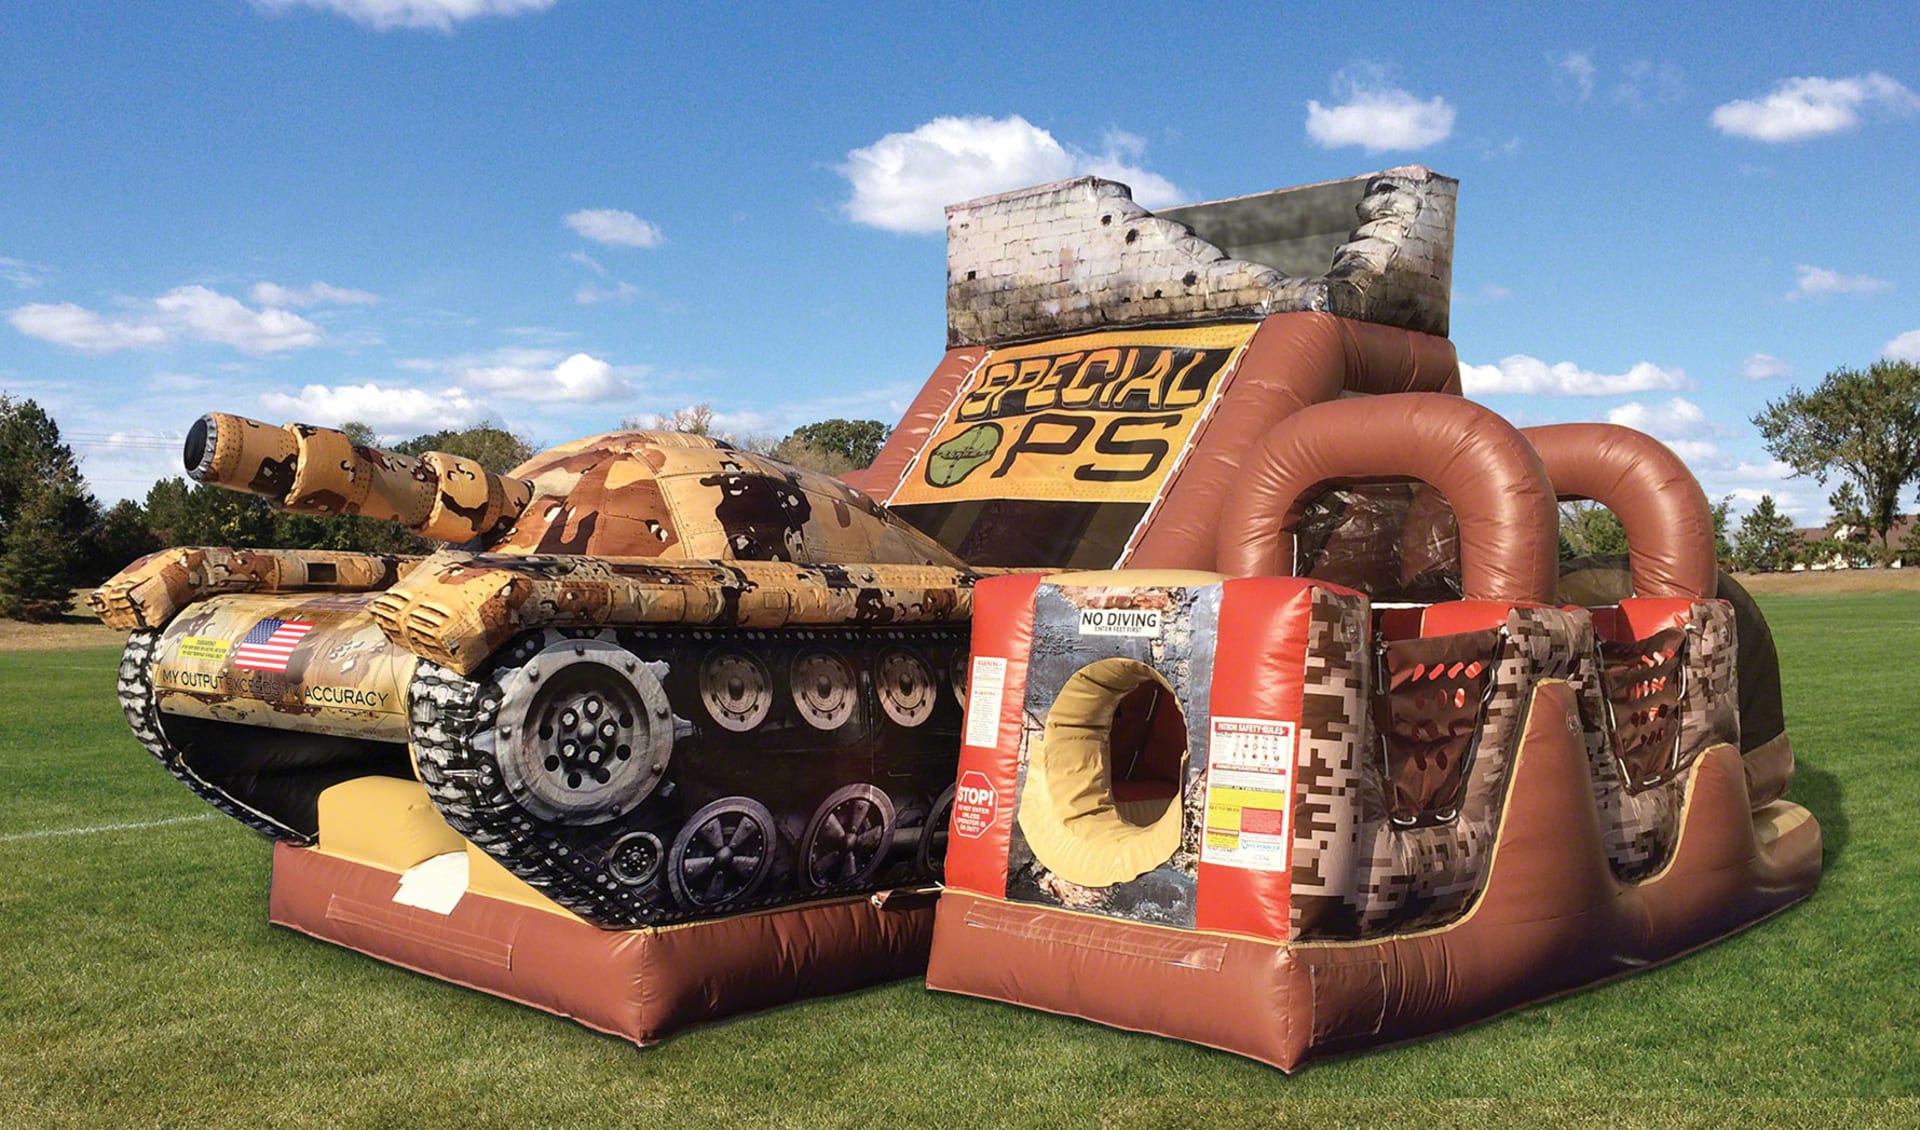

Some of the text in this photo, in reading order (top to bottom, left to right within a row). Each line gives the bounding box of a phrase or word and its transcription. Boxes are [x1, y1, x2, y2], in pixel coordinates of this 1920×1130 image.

[957, 347, 1212, 421] SPECIAL
[1081, 612, 1157, 628] NO DIVING
[162, 669, 179, 684] MY
[181, 671, 224, 690] OUTPUT
[226, 677, 280, 697] EXCEEDS
[304, 685, 390, 708] ACCURACY
[957, 786, 994, 807] STOP!
[972, 805, 989, 815] ENTER
